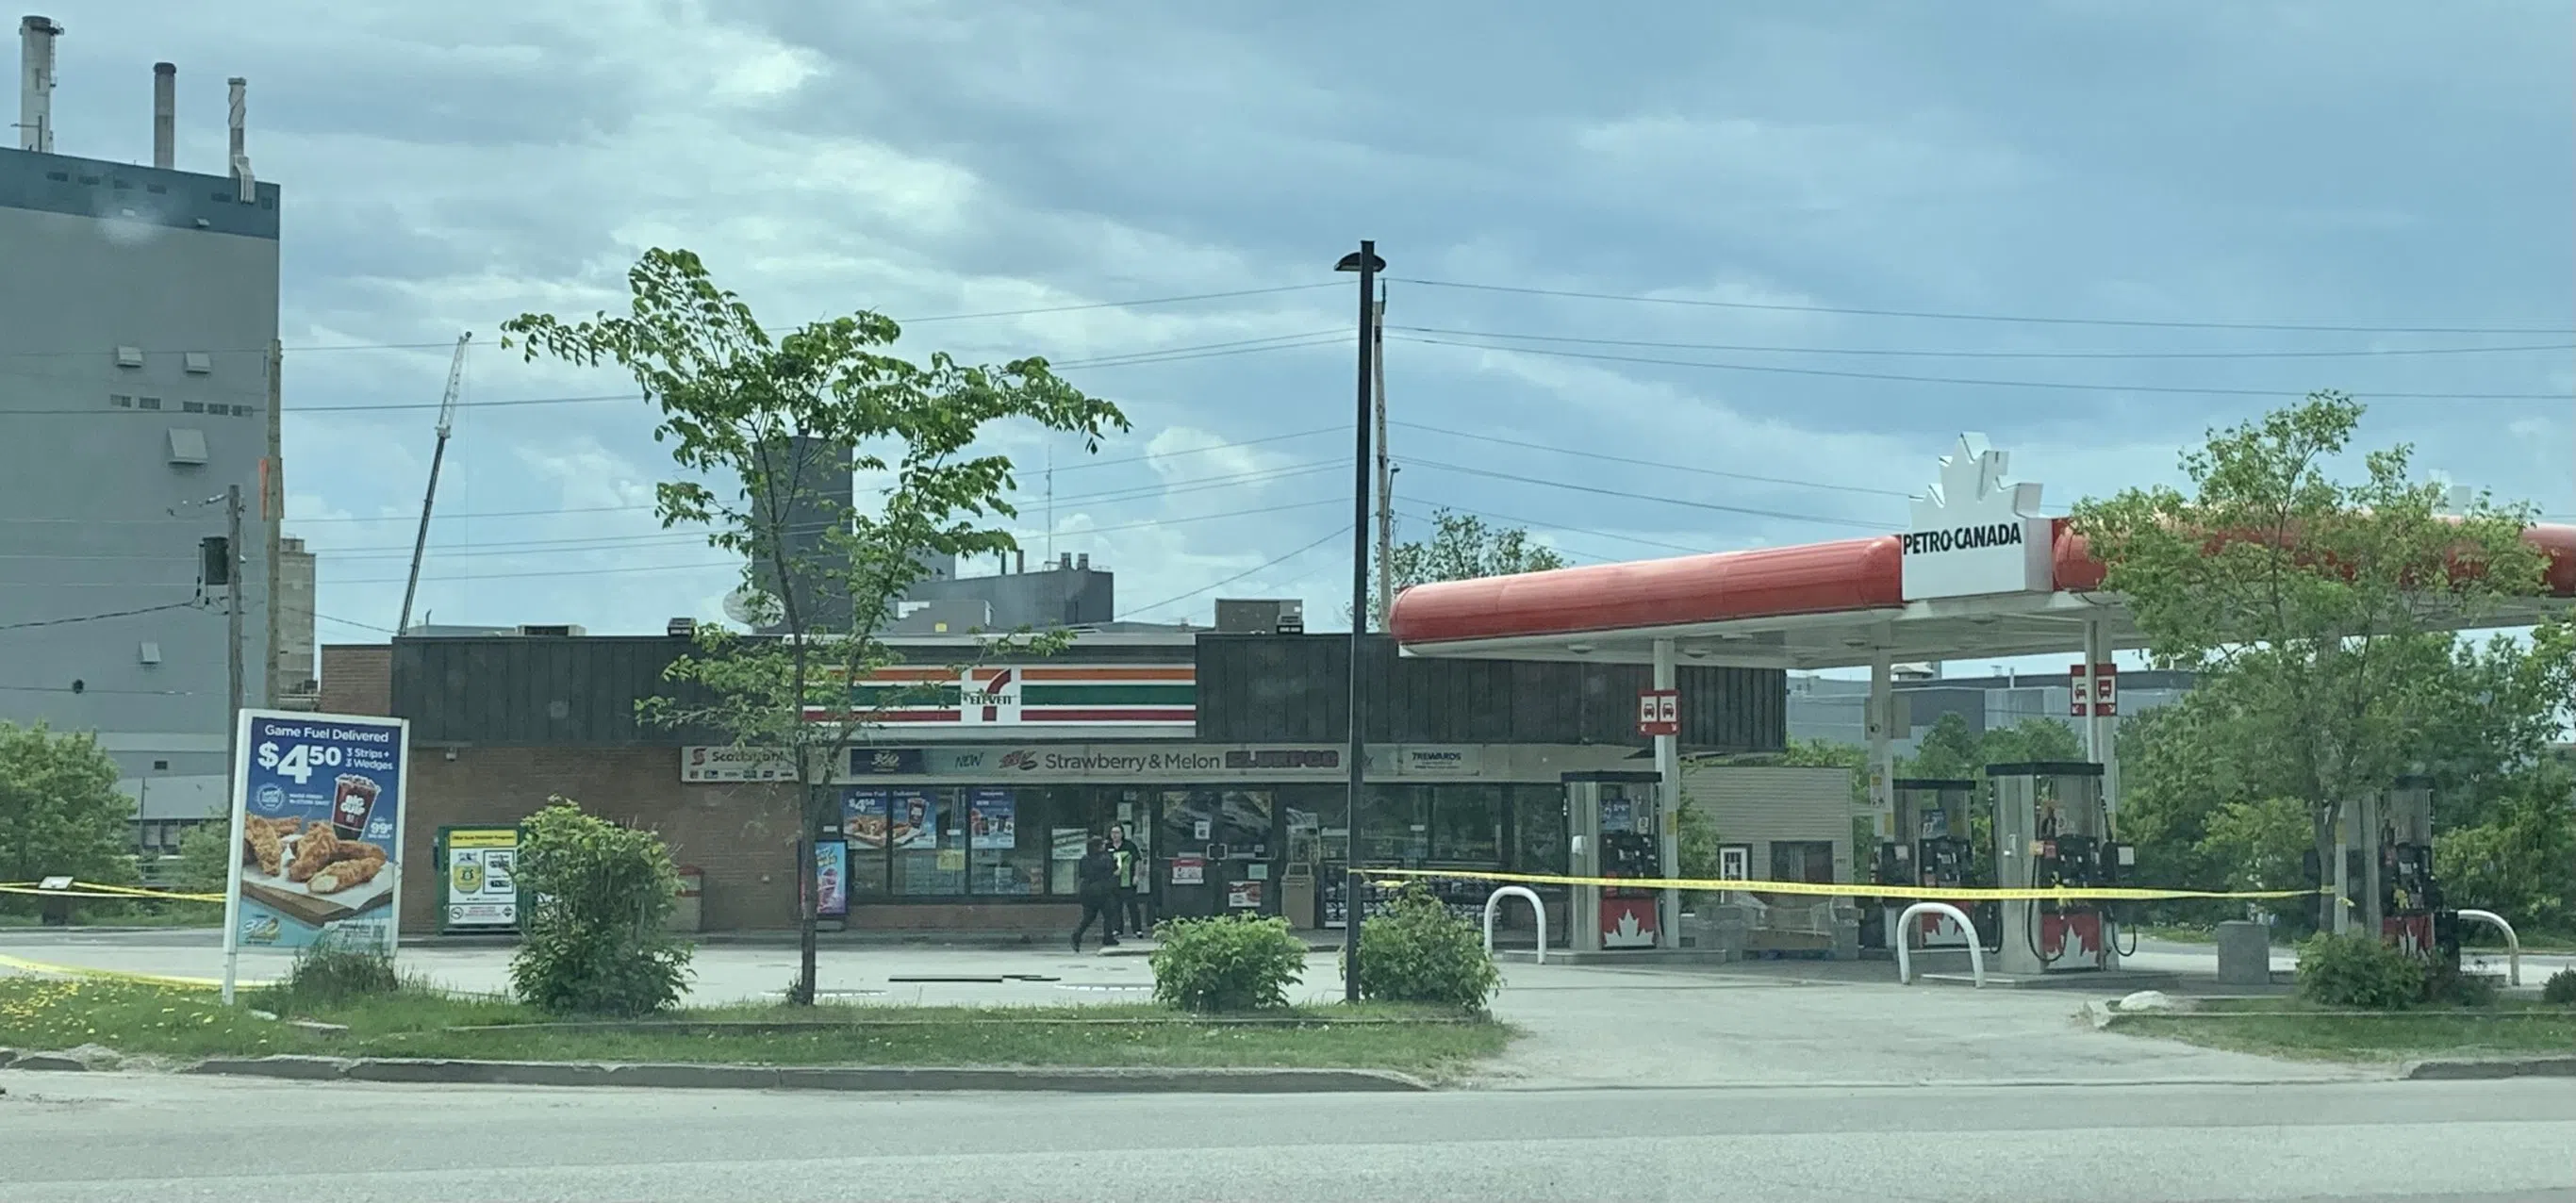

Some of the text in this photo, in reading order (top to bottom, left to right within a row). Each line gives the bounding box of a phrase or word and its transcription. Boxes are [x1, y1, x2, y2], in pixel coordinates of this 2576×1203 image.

[982, 668, 1012, 722] 7
[264, 724, 389, 743] Game Fuel Delivered
[345, 747, 353, 757] 3
[954, 752, 985, 768] NEW
[345, 757, 393, 771] 3 Wedges
[1045, 752, 1148, 772] Strawberry
[1148, 753, 1162, 769] &
[1164, 752, 1221, 769] Melon
